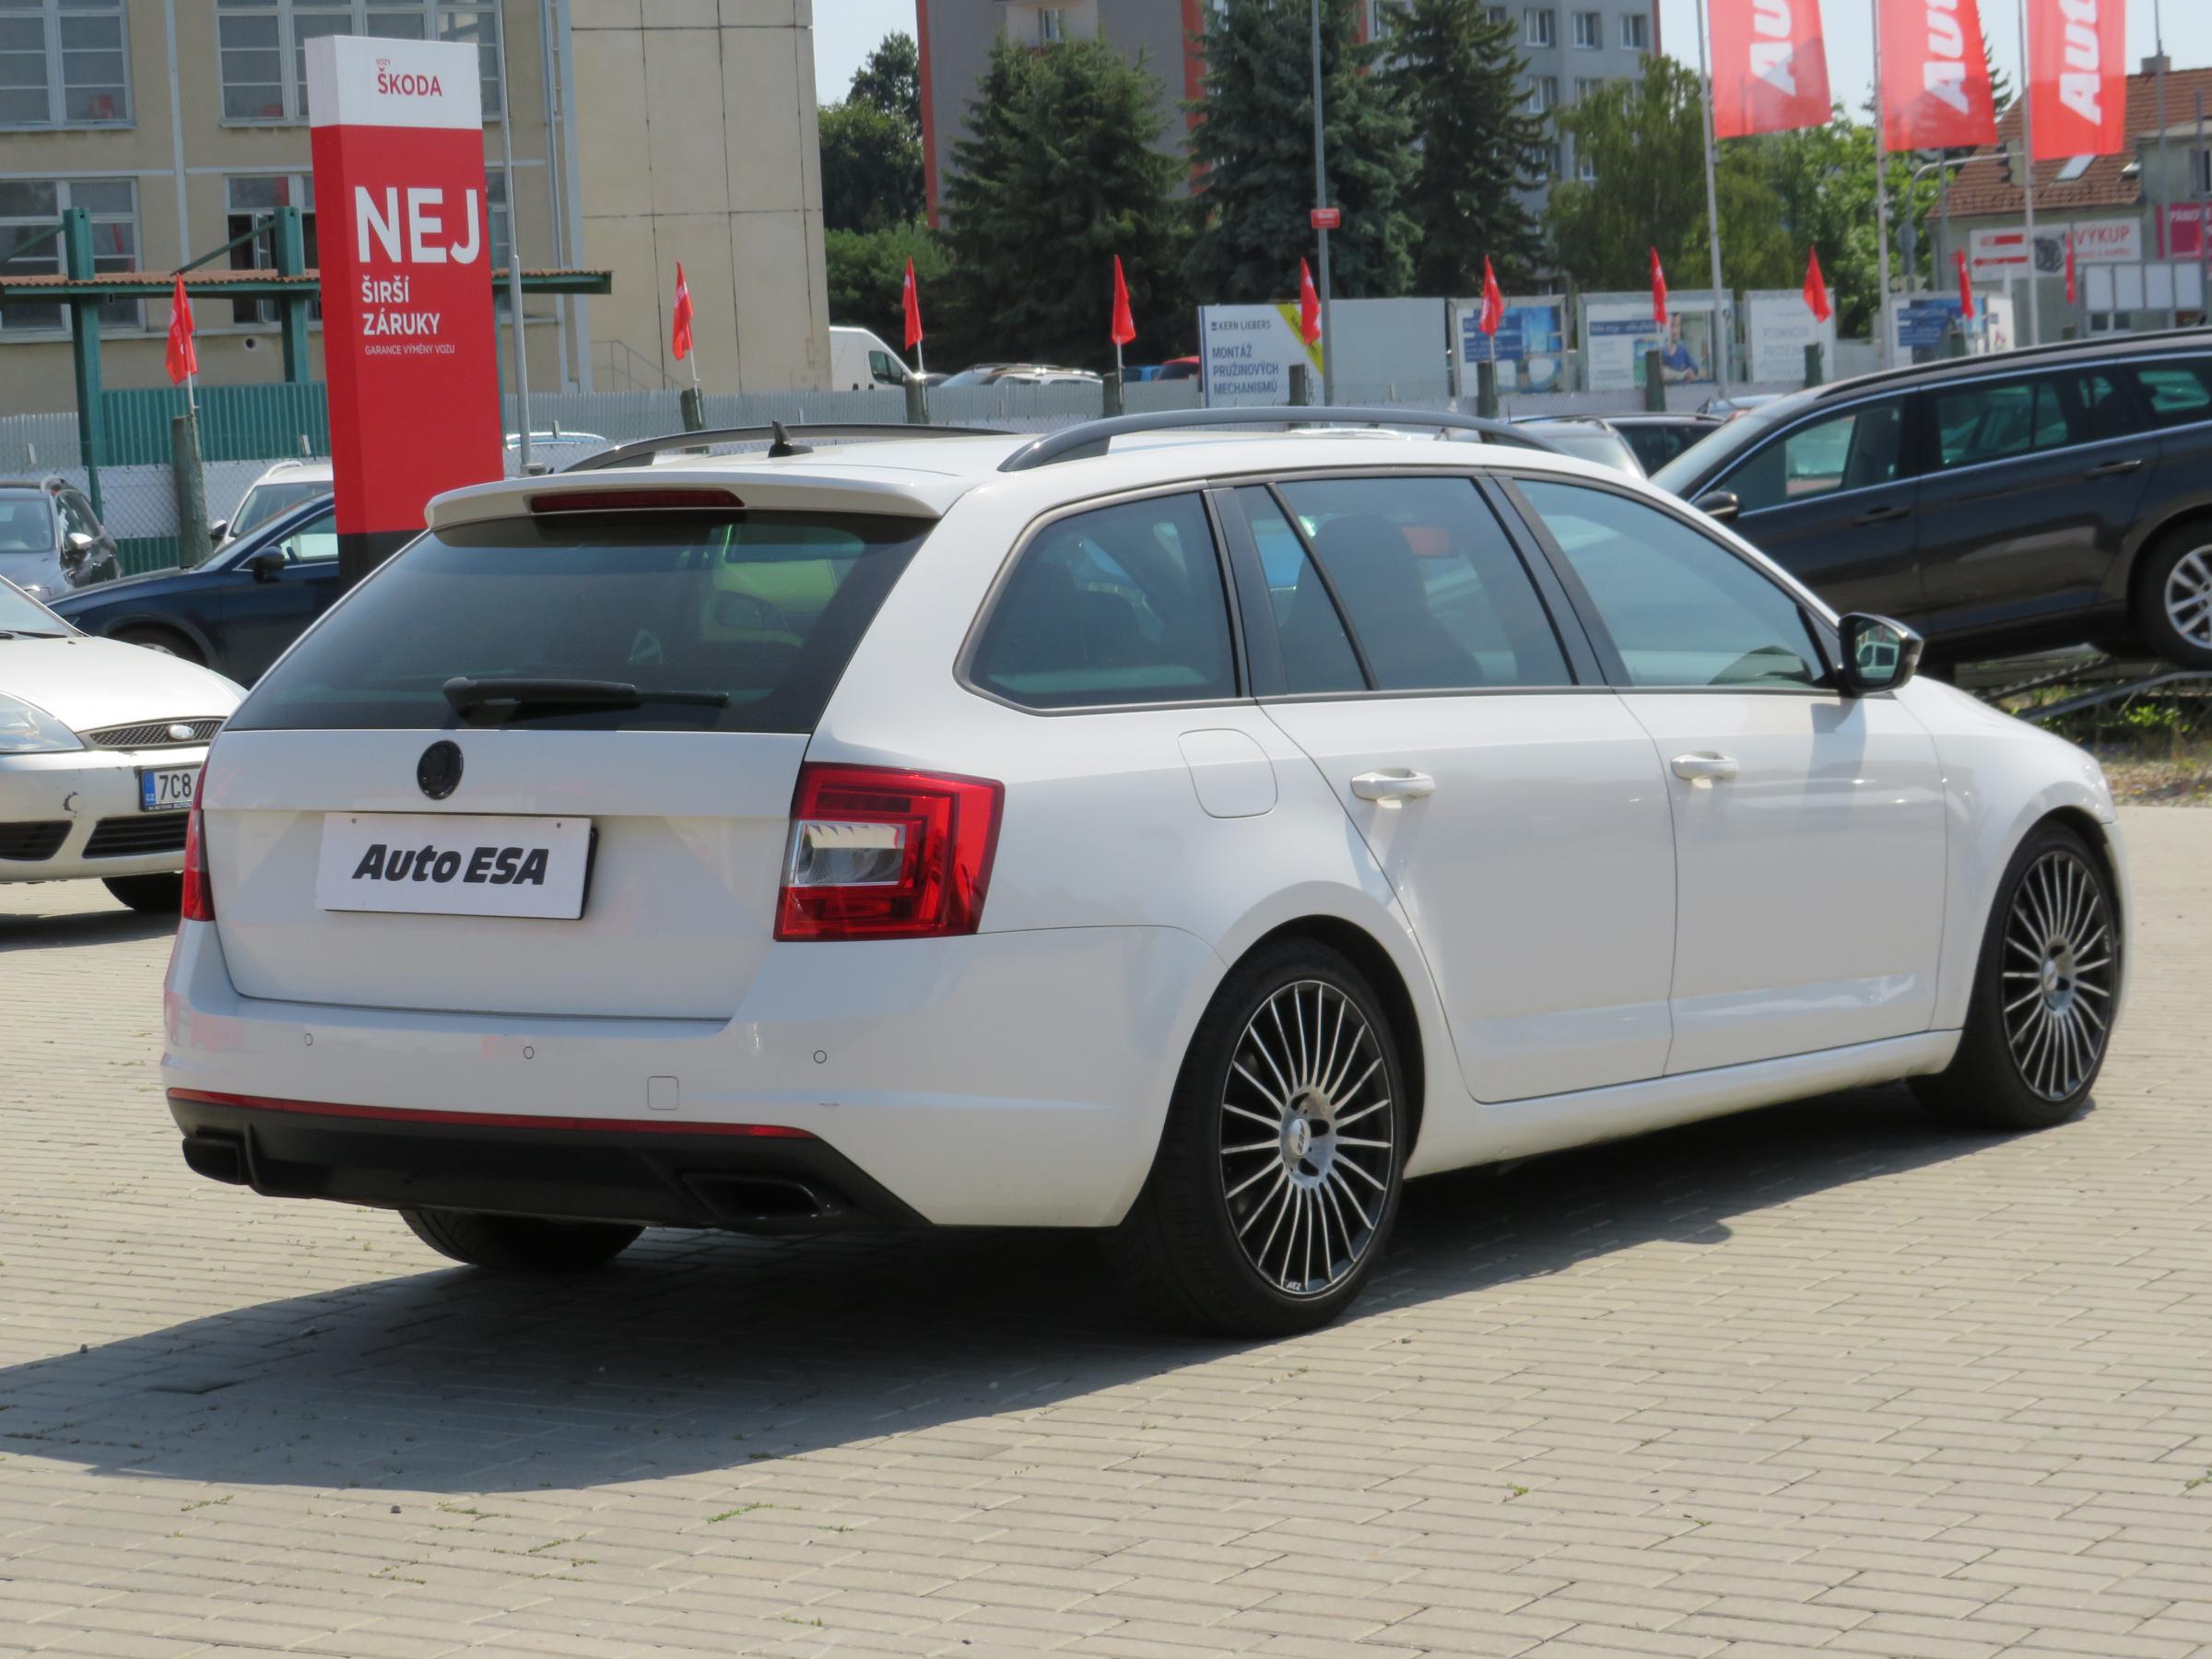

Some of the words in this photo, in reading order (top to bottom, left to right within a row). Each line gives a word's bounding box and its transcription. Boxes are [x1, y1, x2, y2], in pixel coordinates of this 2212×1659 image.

[375, 58, 391, 66] VOZY
[378, 66, 443, 97] ŠKODA
[355, 186, 481, 265] NEJ
[361, 275, 410, 303] ŠIRŠÍ
[362, 307, 441, 335] ZÁRUKY
[1218, 321, 1239, 331] KERN
[1241, 320, 1271, 330] LIEBERS
[365, 346, 402, 355] GARANCE
[404, 343, 433, 355] VÝMĚNY
[435, 345, 455, 354] VOZU
[1212, 342, 1253, 359] MONTÁŽ
[1213, 359, 1279, 377] PRUŽINOVÝCH
[159, 772, 192, 800] 7C8
[351, 843, 462, 883] Auto
[463, 846, 549, 886] ESA
